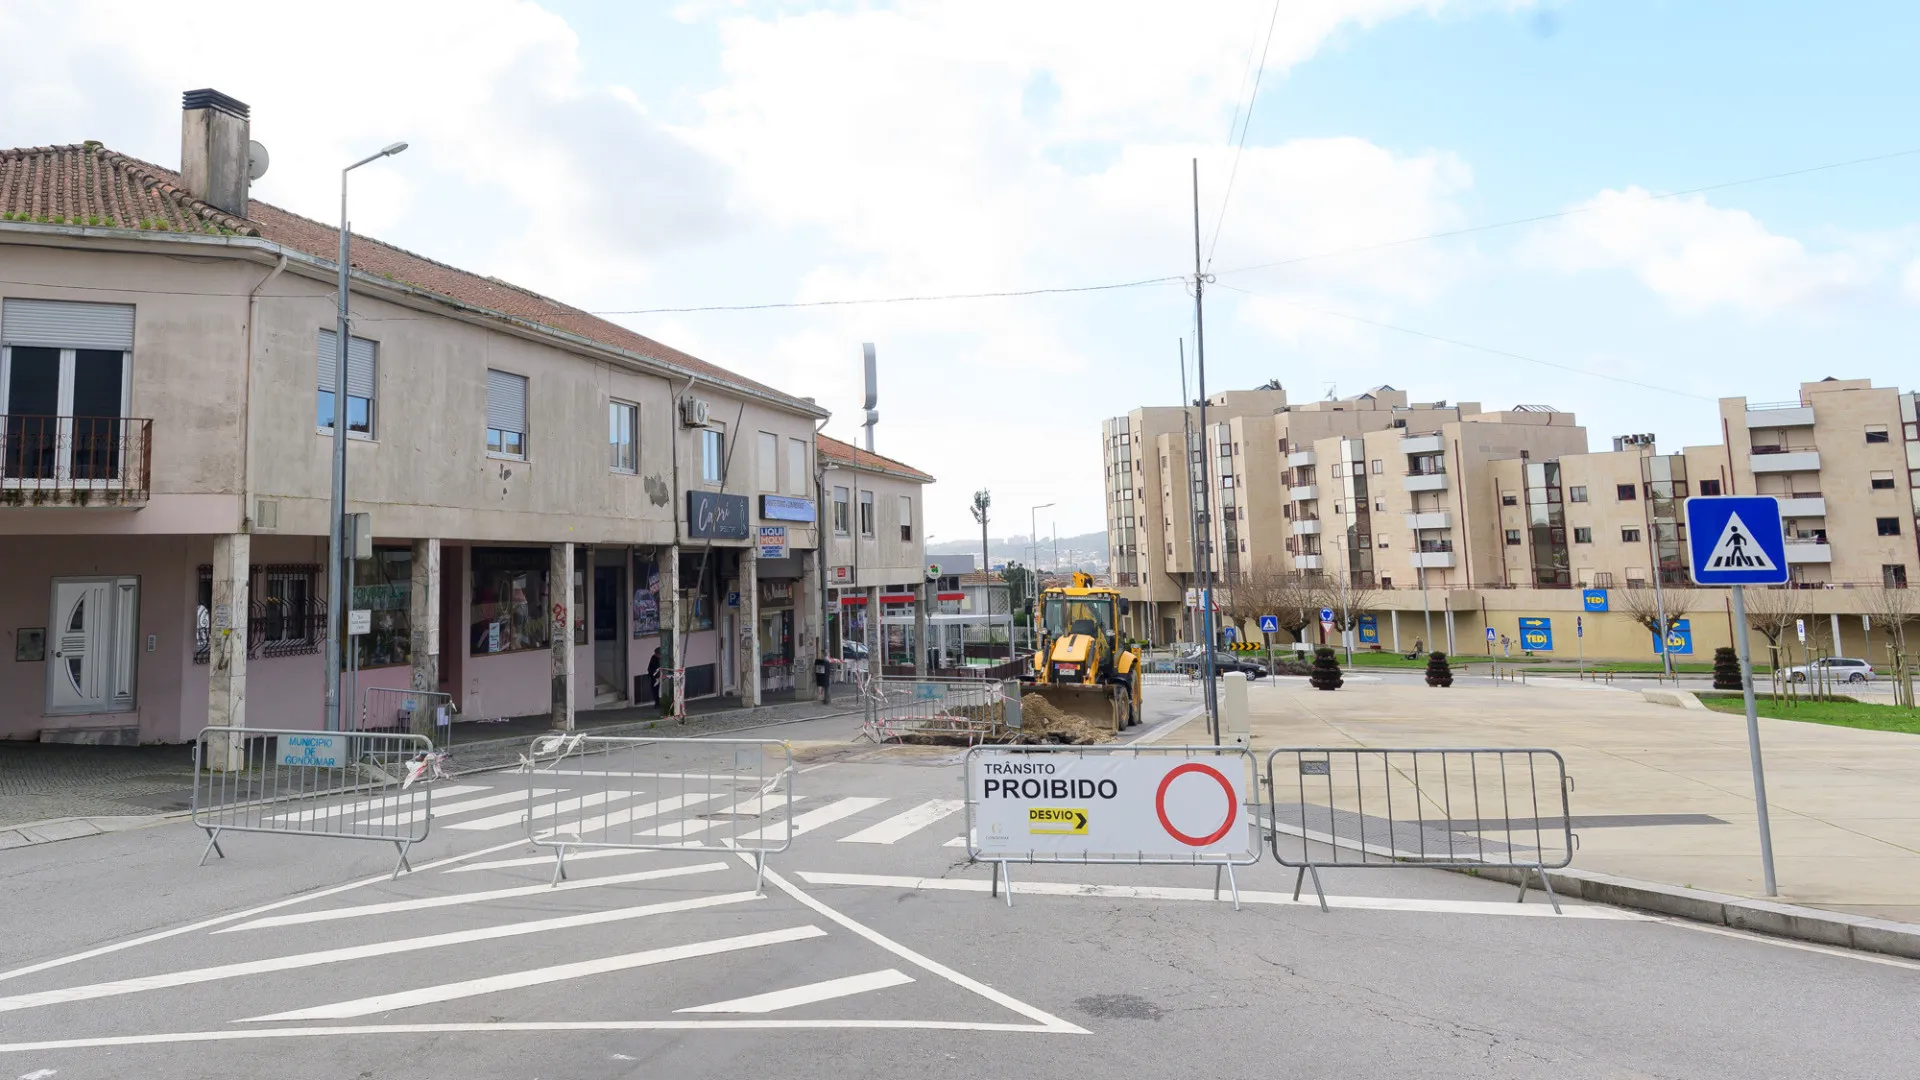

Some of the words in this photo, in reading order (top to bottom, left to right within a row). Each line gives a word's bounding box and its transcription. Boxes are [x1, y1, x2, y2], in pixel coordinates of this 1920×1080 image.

[761, 527, 784, 536] LIQUI
[761, 536, 784, 545] MOLY
[304, 747, 316, 756] DE
[285, 755, 335, 766] GONDOMAR
[984, 761, 1056, 775] TRÂNSITO
[984, 778, 1118, 799] PROIBIDO
[1029, 809, 1074, 820] DESVIO
